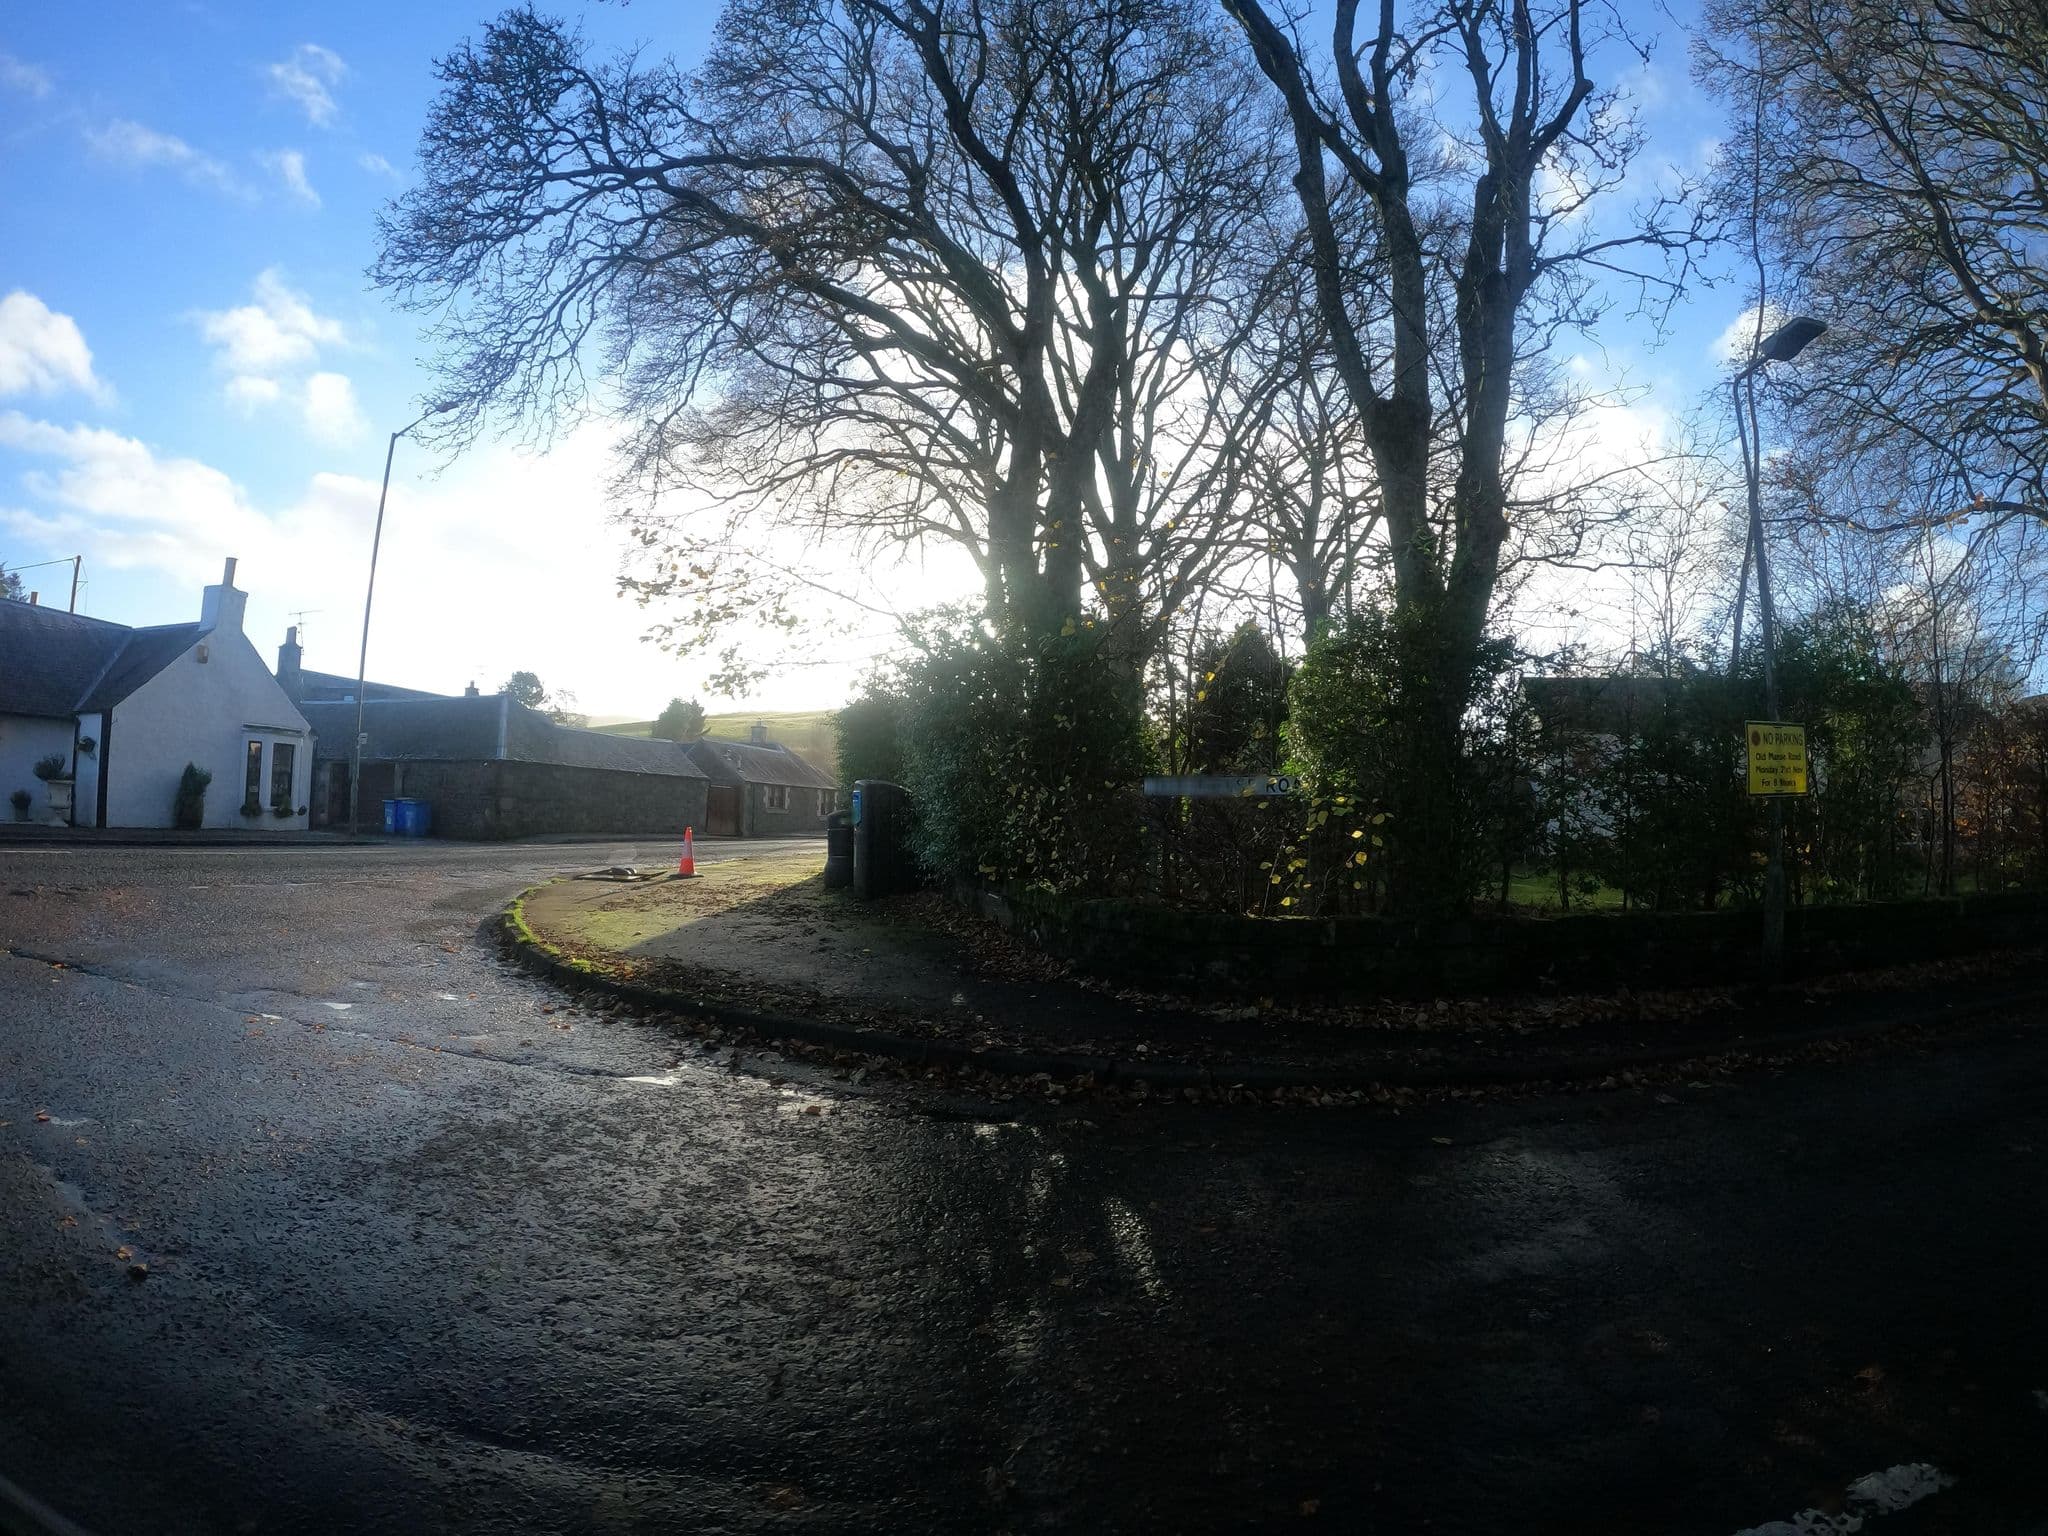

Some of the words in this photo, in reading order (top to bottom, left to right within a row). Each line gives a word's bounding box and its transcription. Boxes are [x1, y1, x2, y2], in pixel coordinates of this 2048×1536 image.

[1763, 732, 1773, 744] NO
[1775, 733, 1803, 746] PARKING
[1756, 752, 1766, 760] Old
[1756, 766, 1778, 775] Monday
[1761, 778, 1770, 786] For
